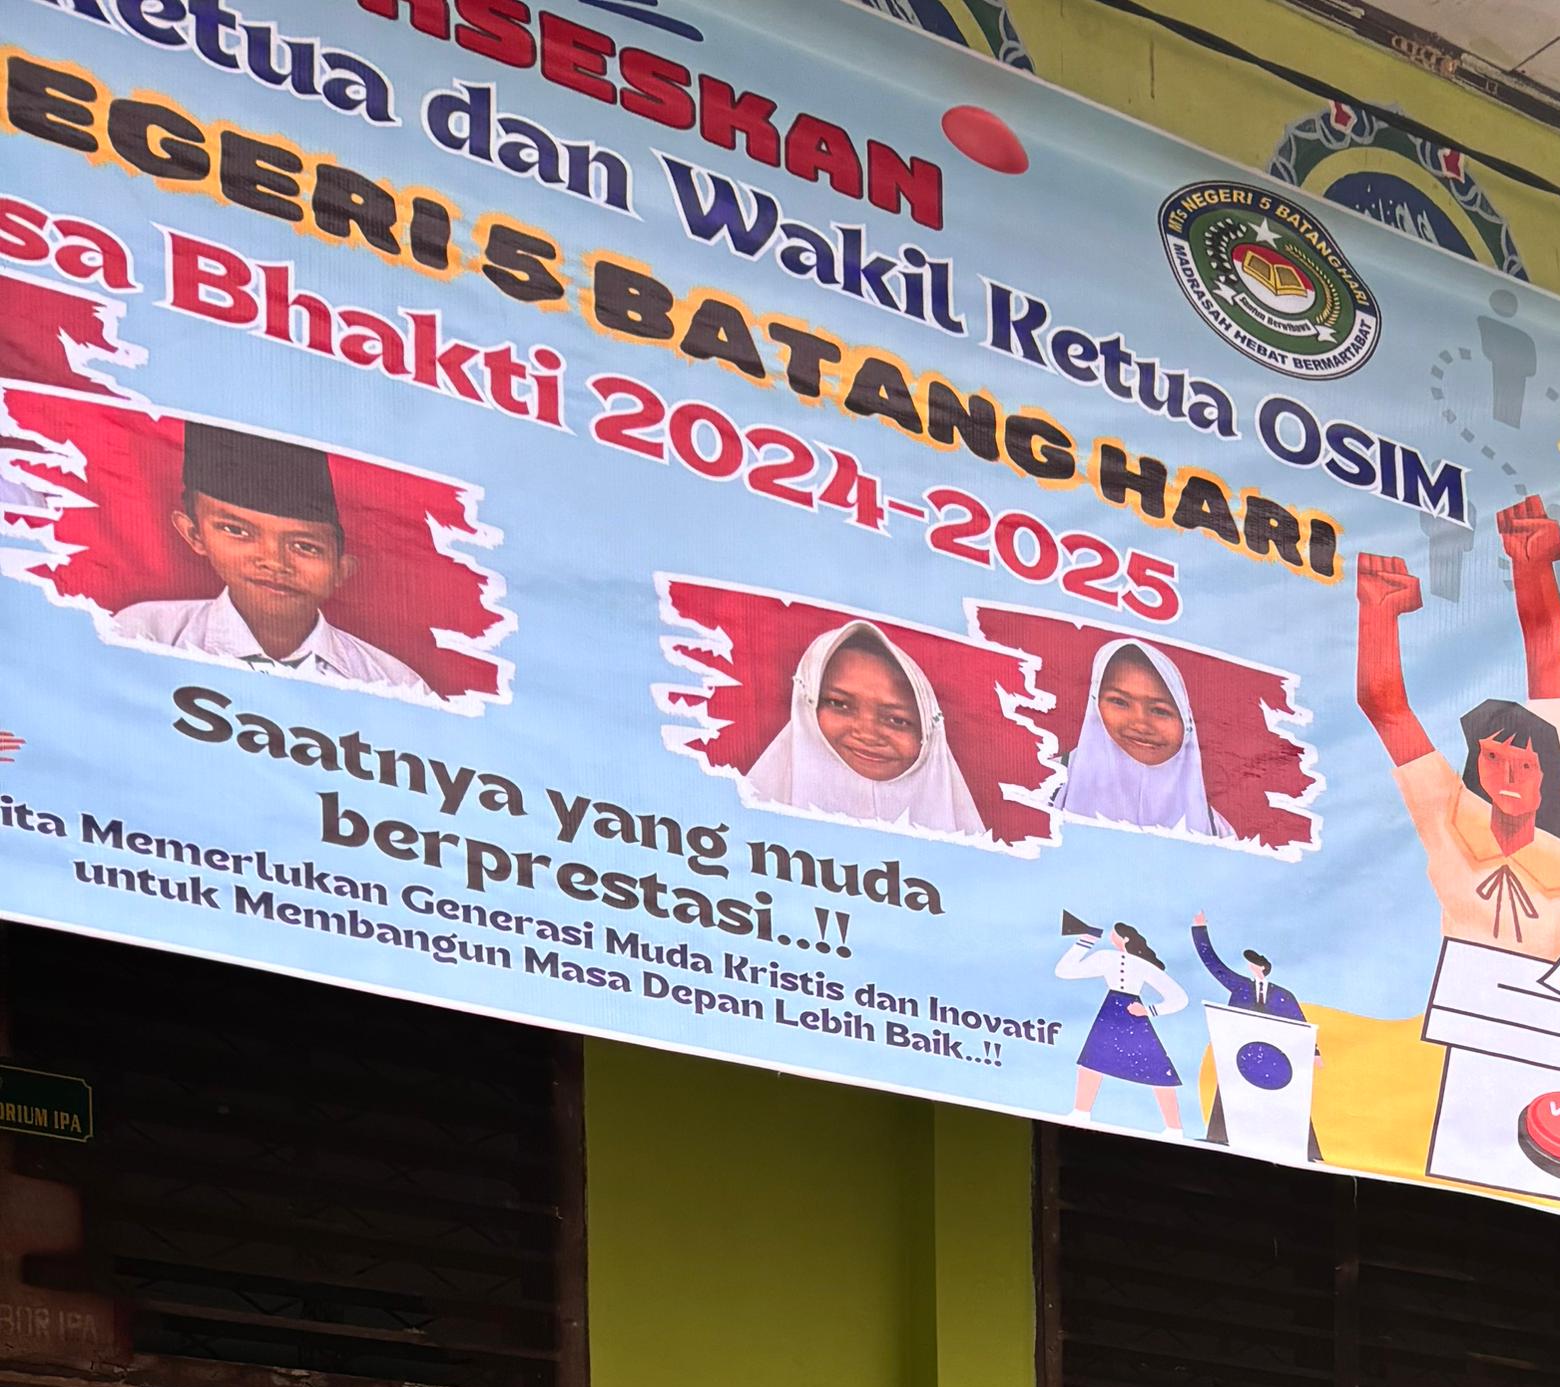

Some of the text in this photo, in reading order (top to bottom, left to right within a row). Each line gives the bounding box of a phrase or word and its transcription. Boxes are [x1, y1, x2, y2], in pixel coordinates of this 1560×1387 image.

[40, 0, 1470, 526] etua dan Wakil Ketua OSIM
[1173, 243, 1372, 370] MADRASAH HEBAT BERMARTABAT
[1181, 189, 1253, 213] NEGERI
[1259, 197, 1272, 210] 5
[1275, 204, 1370, 307] BATANGHARI
[160, 231, 569, 429] Bhakti
[592, 378, 1180, 622] 2024-2025
[481, 223, 565, 303] 5
[593, 259, 1075, 481] BATANG
[1098, 443, 1337, 578] HARI
[172, 685, 944, 916] Saatnya yang muda
[318, 791, 853, 960] berprestasi..!!
[73, 860, 1004, 1068] untuk Membangun Masa Depan Lebih Baik..!!
[81, 813, 388, 907] Memerlukan
[402, 882, 594, 950] Generasi
[605, 929, 714, 976] Muda
[723, 953, 845, 1003] Kristis
[856, 982, 926, 1014] dan
[928, 996, 1061, 1048] Inovatif
[53, 1110, 82, 1133] IPA
